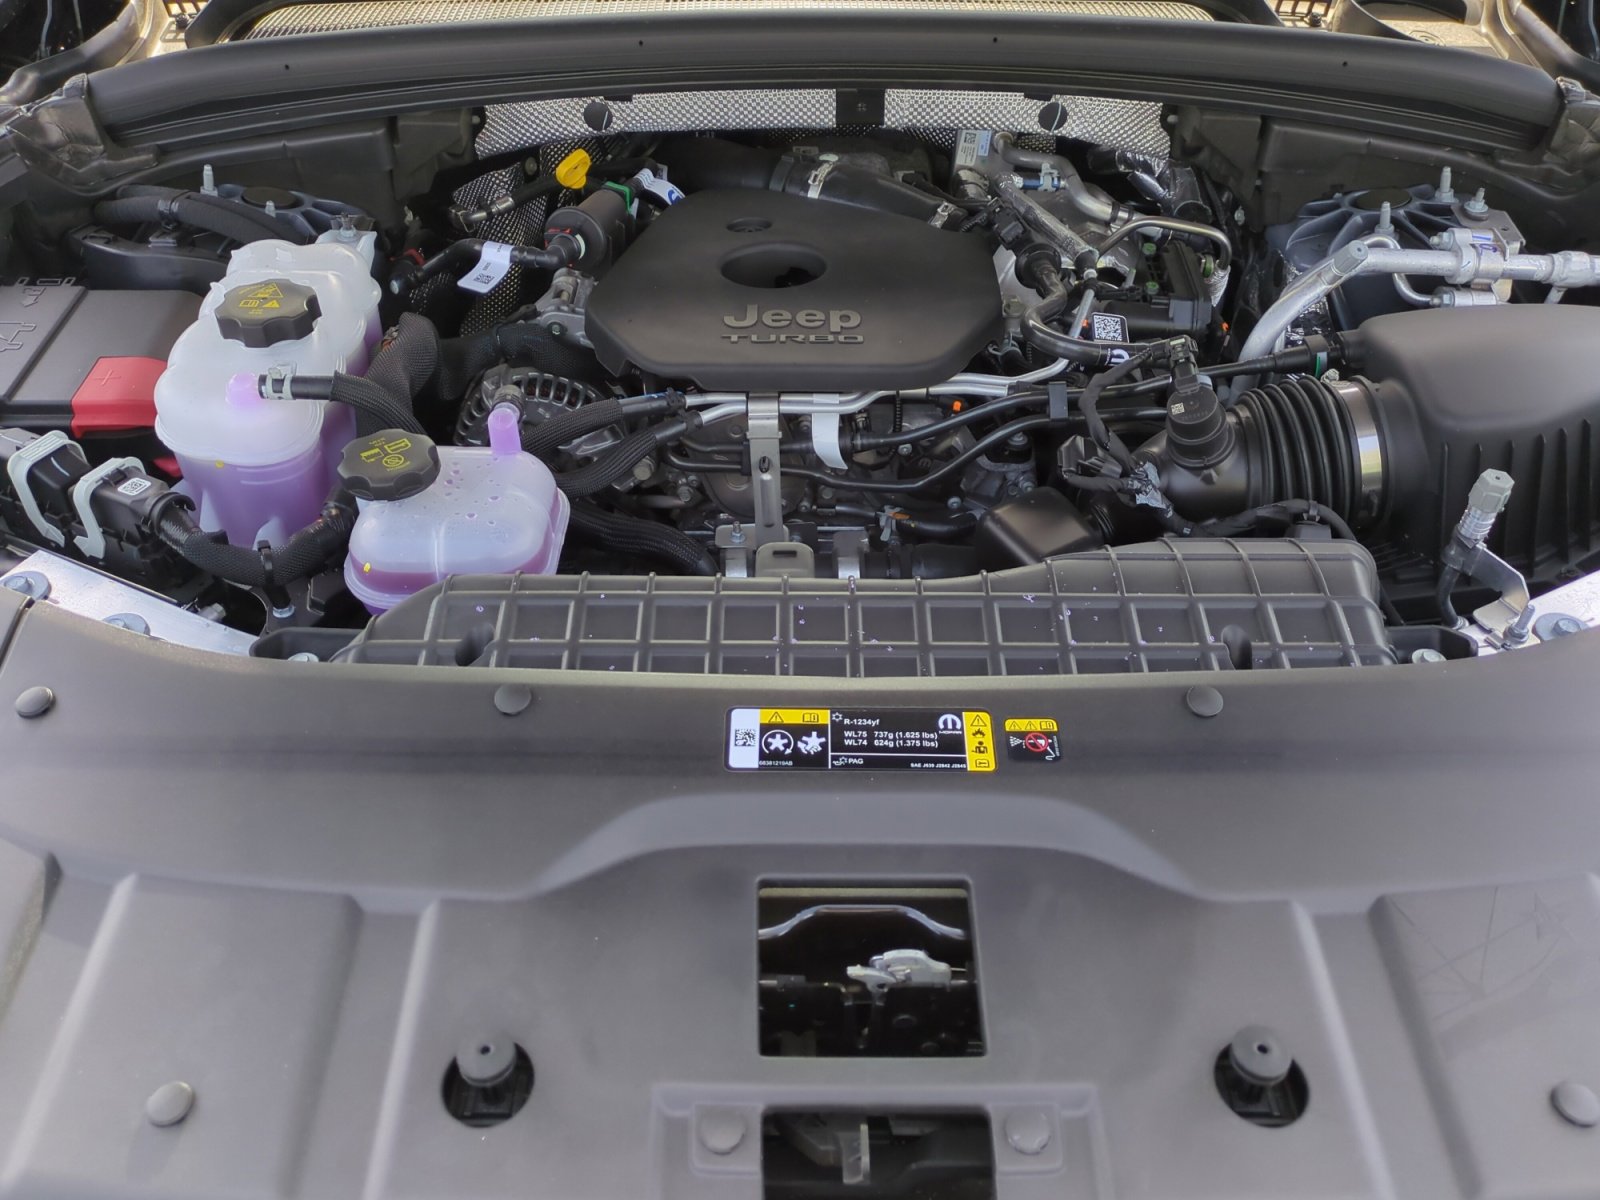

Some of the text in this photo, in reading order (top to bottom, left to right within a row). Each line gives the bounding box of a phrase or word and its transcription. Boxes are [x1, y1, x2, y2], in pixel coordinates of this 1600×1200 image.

[723, 304, 862, 333] Jeep
[721, 334, 865, 344] TURBO
[843, 718, 880, 727] R-1234yf
[843, 730, 938, 740] WL75 737g (1.625 lbs)
[874, 740, 894, 748] 624g
[896, 740, 921, 748] (1.375
[922, 740, 939, 748] lbs)
